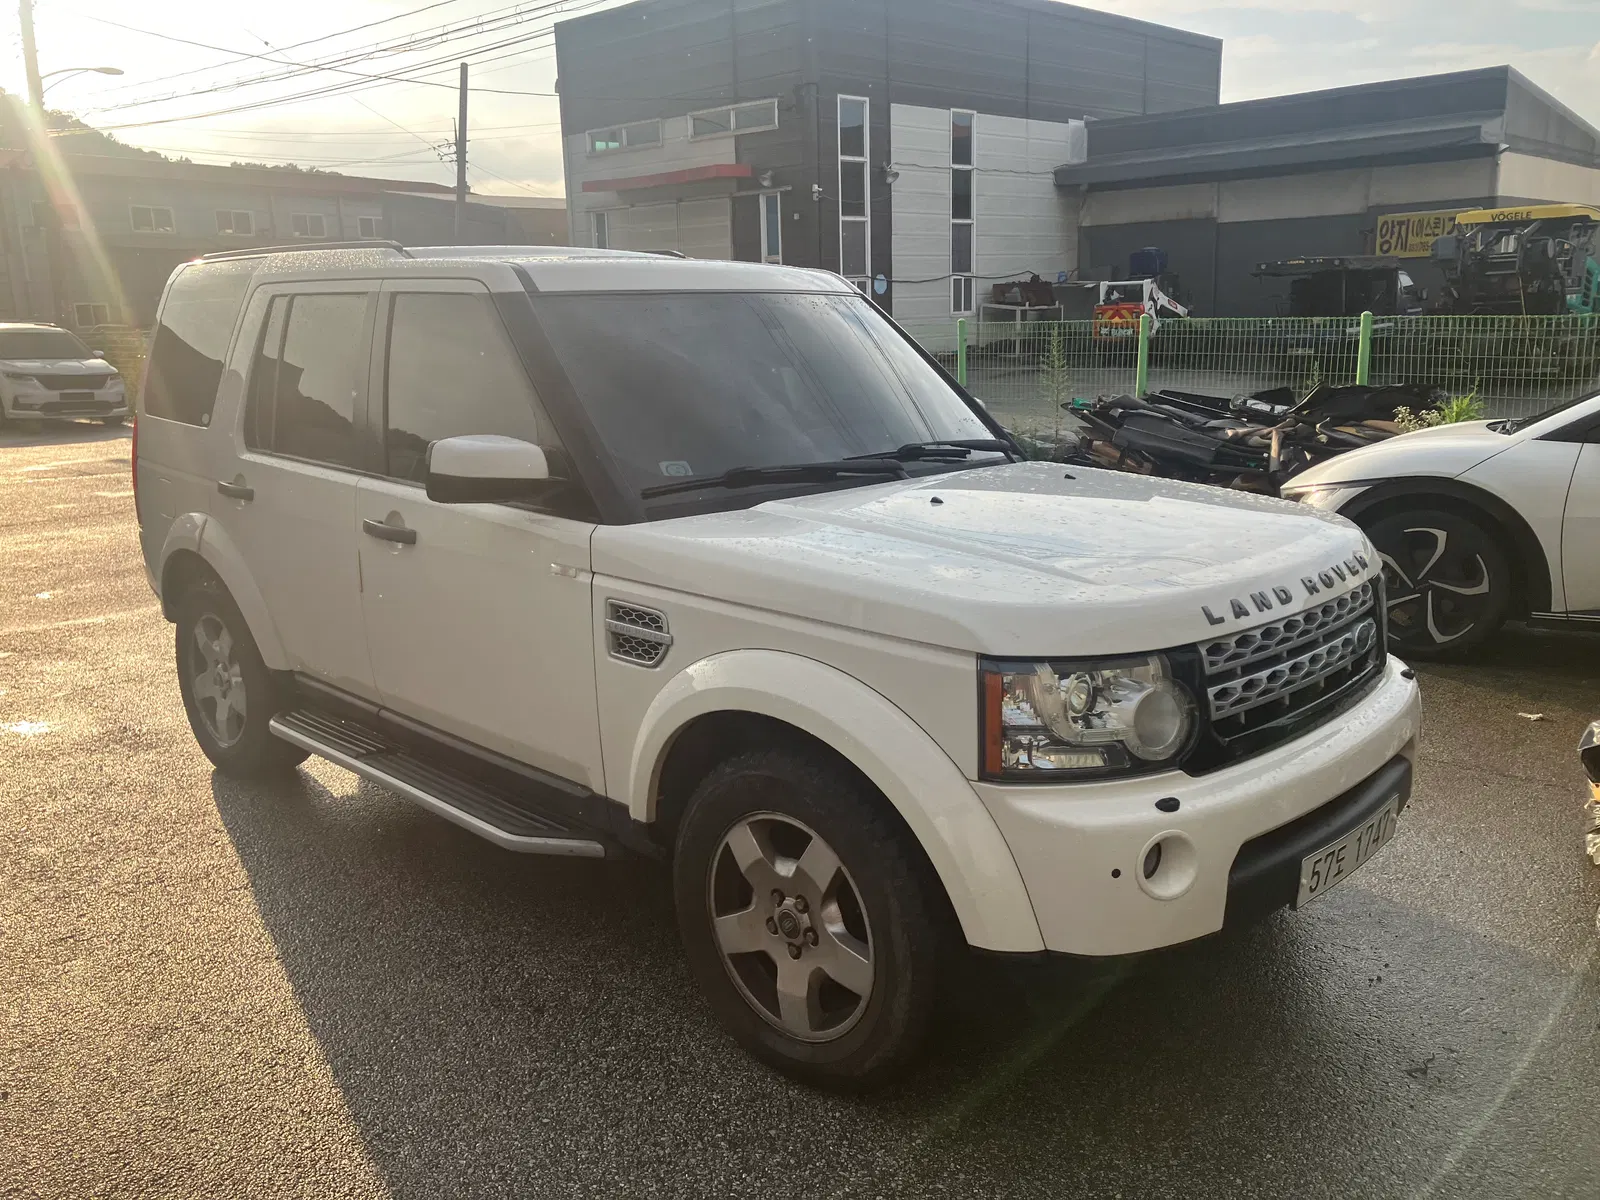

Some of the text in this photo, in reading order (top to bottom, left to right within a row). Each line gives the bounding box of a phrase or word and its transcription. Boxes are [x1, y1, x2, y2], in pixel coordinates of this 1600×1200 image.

[1491, 211, 1532, 221] VÖGELE
[1201, 552, 1368, 626] LAND ROVER
